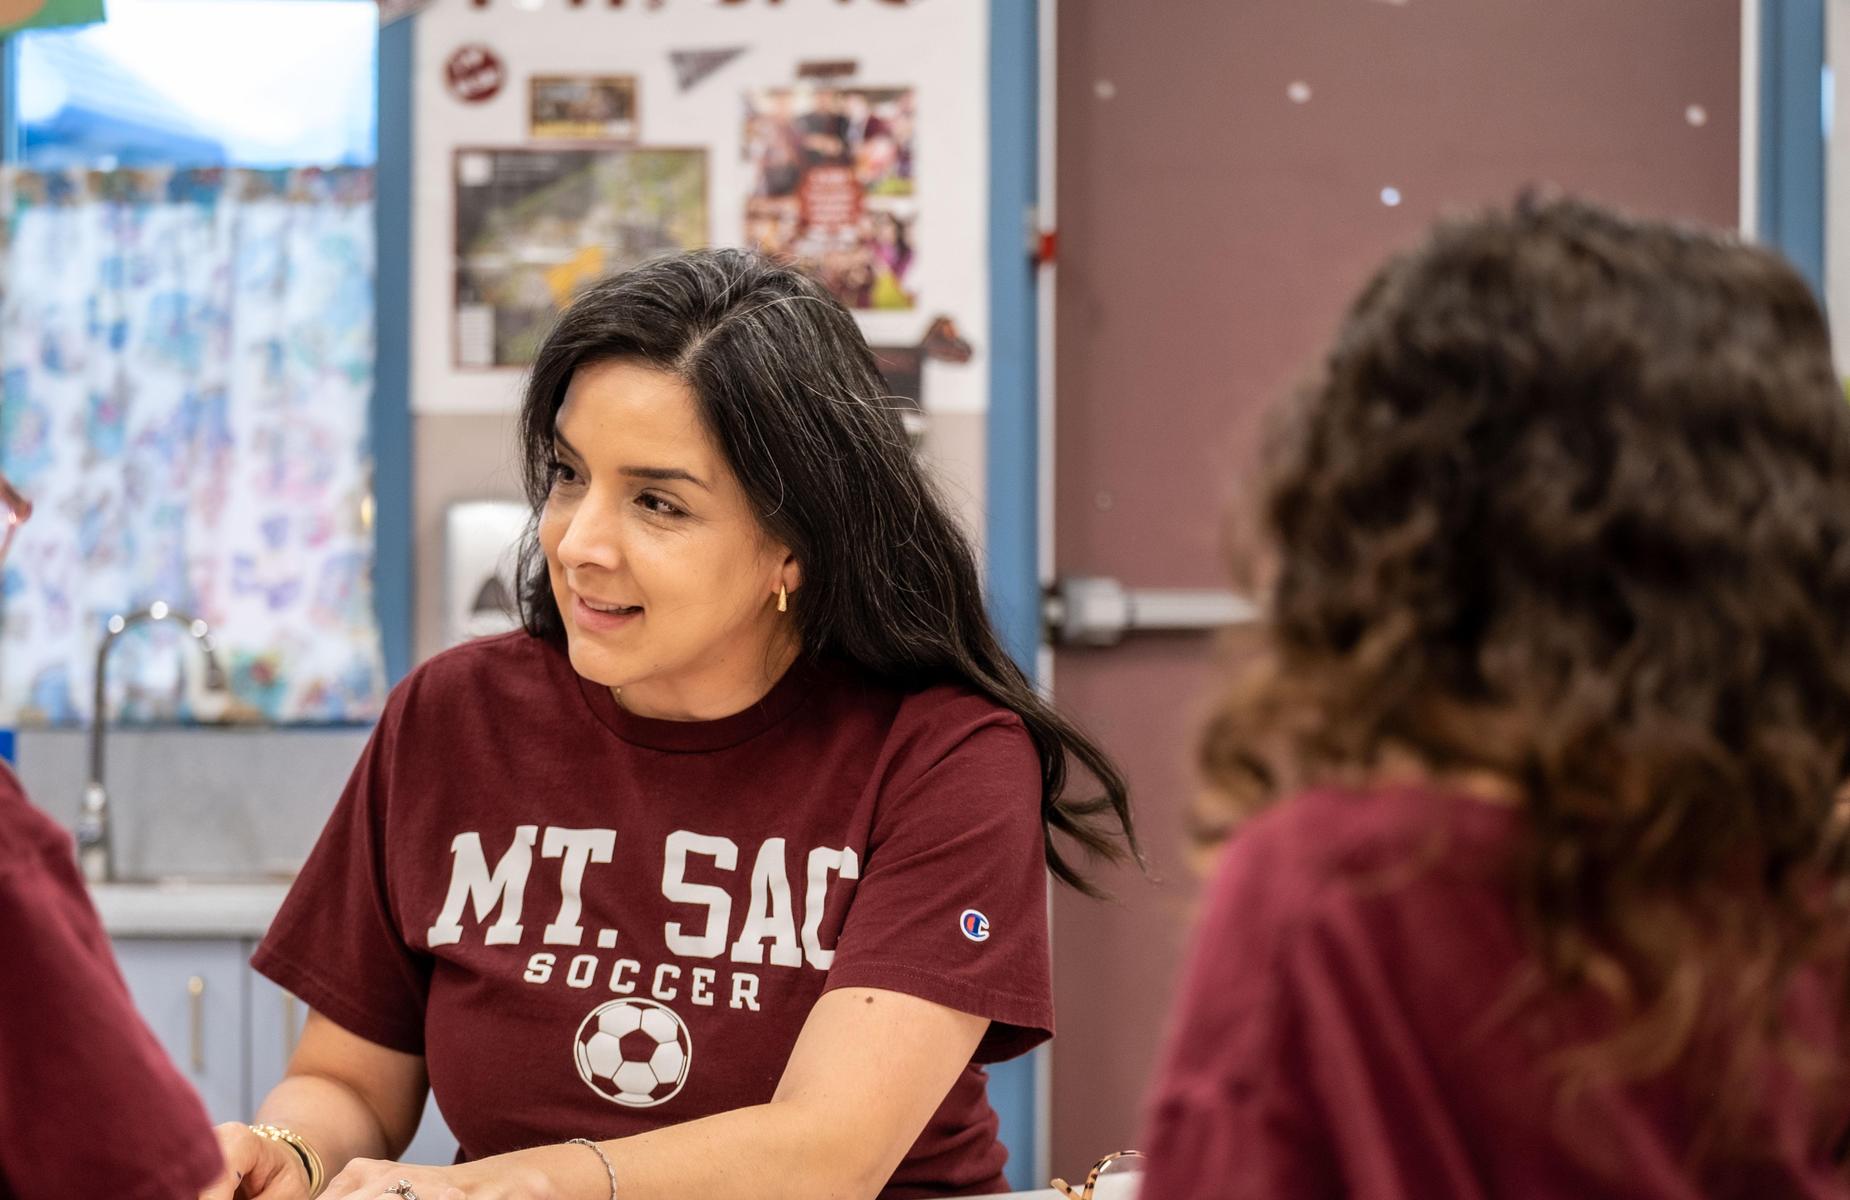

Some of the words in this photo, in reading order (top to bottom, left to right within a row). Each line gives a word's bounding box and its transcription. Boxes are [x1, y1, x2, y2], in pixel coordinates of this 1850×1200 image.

[427, 824, 619, 949] MT.
[661, 829, 859, 971] SAC
[523, 952, 761, 1012] SOCCER
